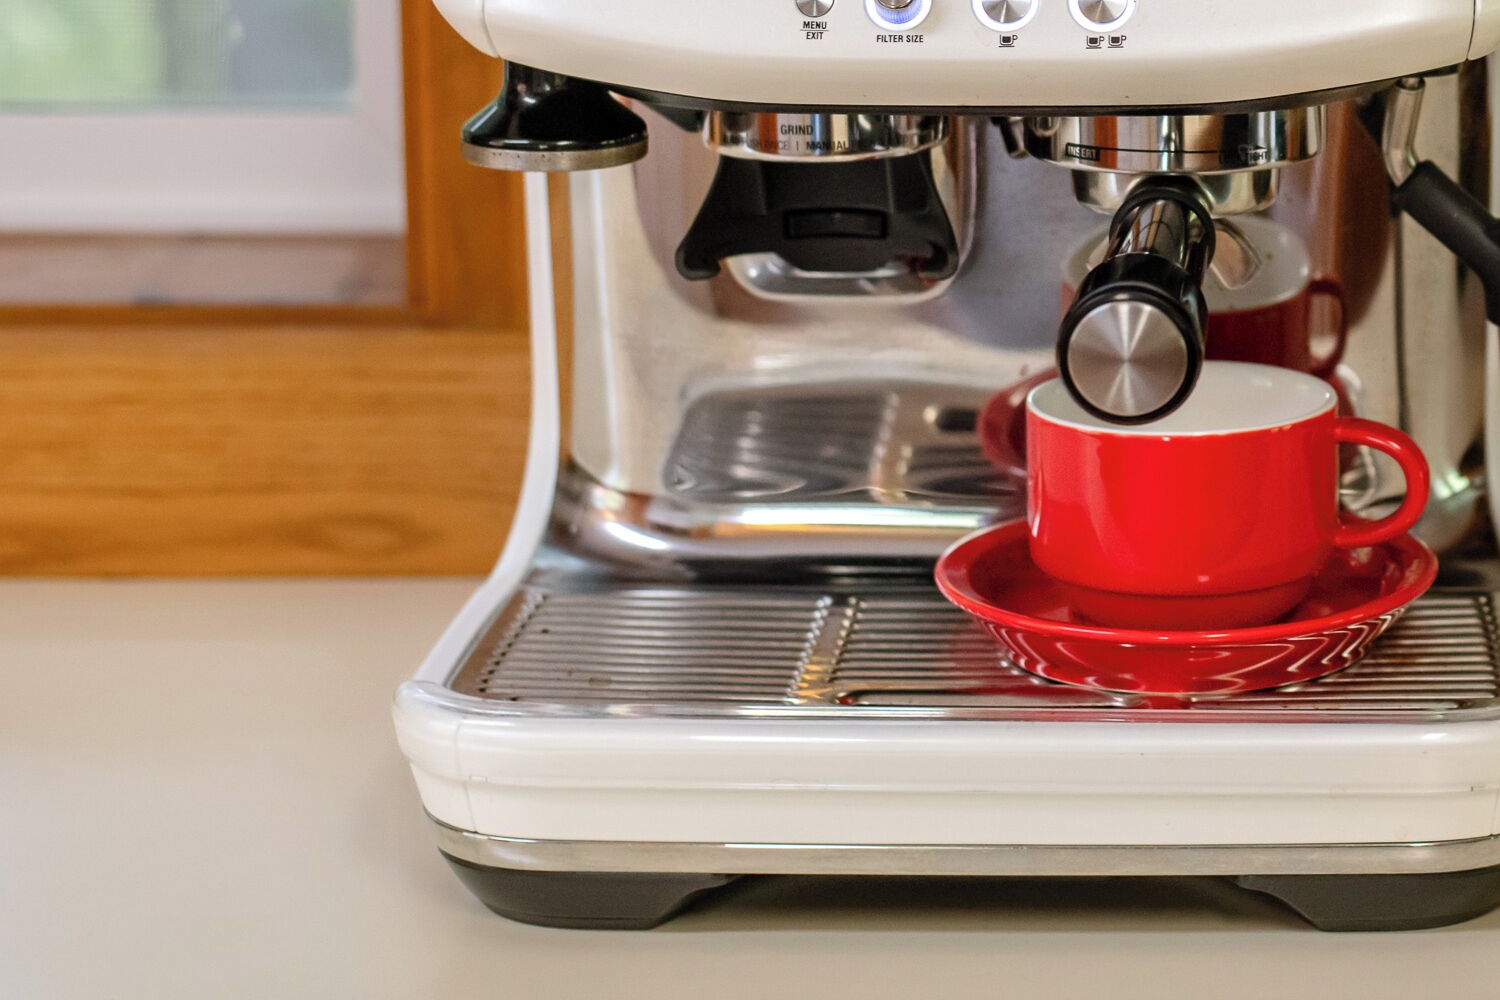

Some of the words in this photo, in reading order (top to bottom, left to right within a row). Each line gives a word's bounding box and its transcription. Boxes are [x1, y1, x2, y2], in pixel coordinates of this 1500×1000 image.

[803, 20, 827, 30] MENU
[806, 31, 823, 40] EXIT
[876, 34, 903, 43] FILTER
[905, 34, 924, 43] SIZE
[780, 124, 814, 136] GRIND
[1067, 145, 1097, 159] INSERT
